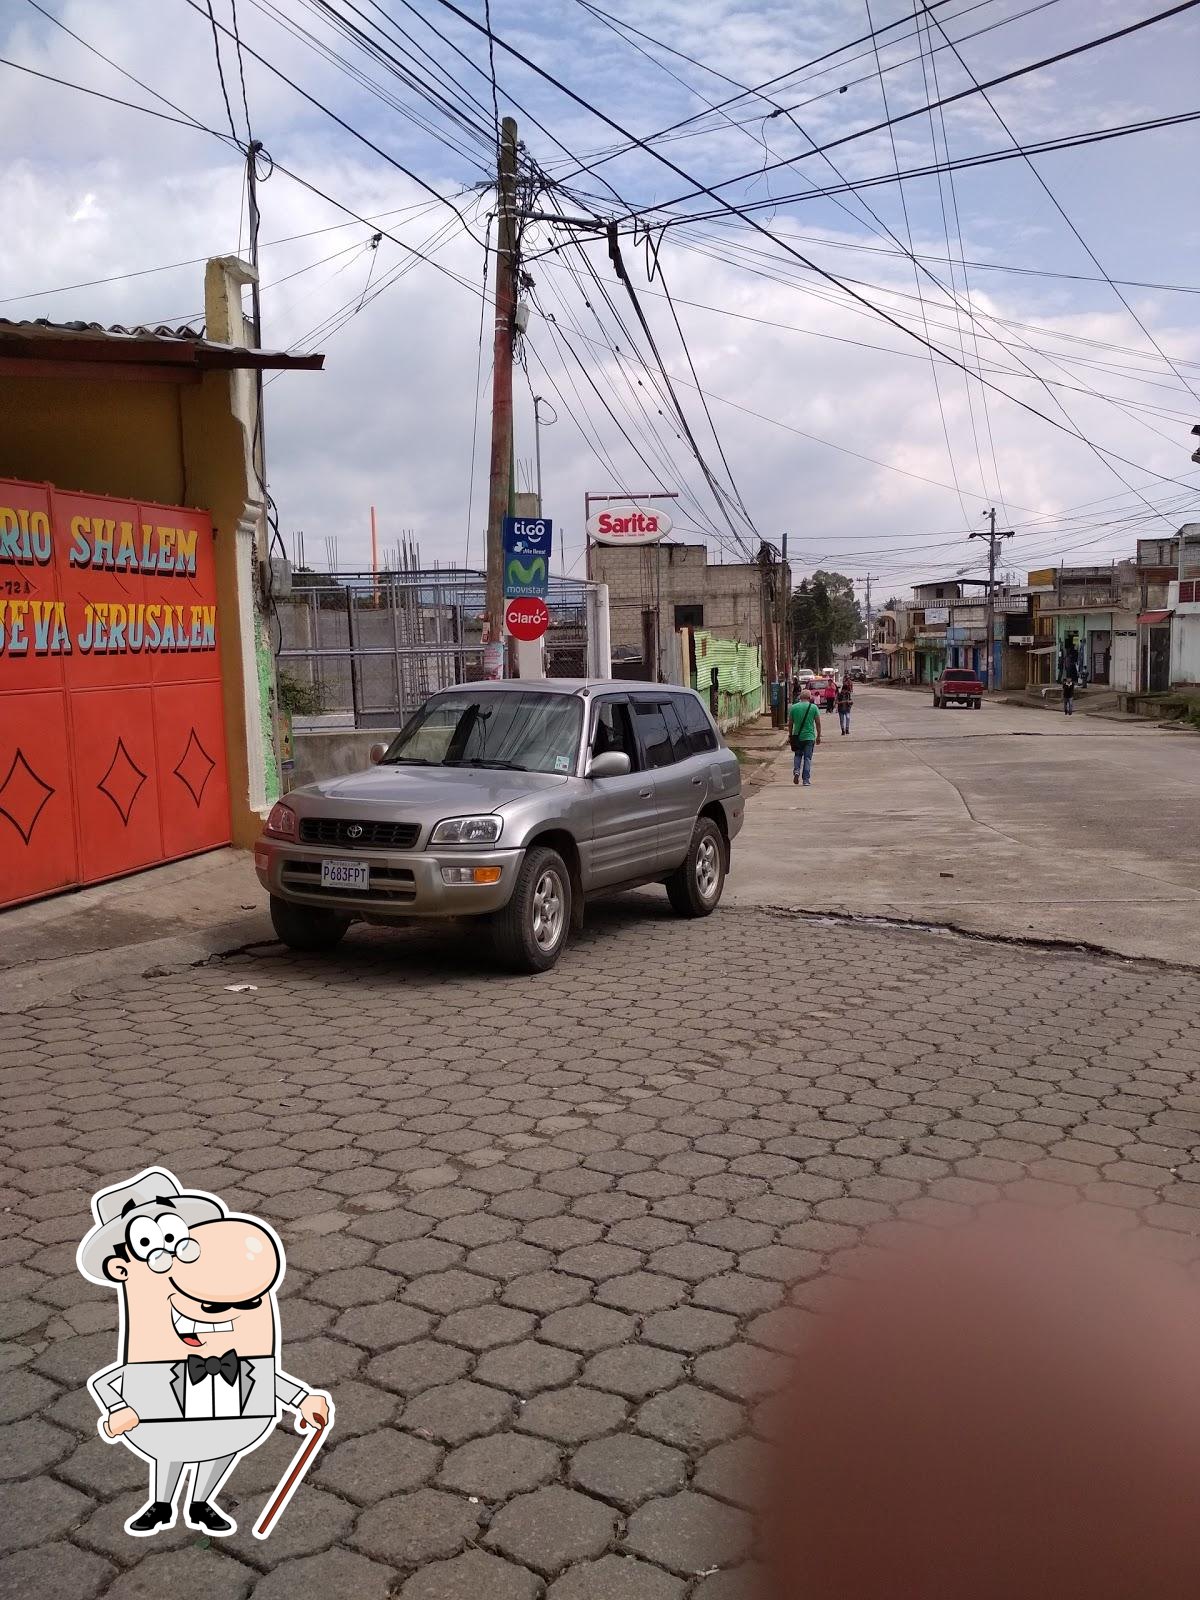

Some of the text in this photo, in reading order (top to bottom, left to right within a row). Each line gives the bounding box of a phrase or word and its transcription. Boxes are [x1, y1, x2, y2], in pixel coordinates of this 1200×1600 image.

[514, 520, 545, 543] tigo
[598, 513, 658, 534] Sarita
[70, 515, 198, 578] SHALEM
[507, 585, 545, 594] movistar
[508, 612, 542, 624] Claro
[78, 603, 216, 655] JERUSALEN
[323, 865, 366, 883] P683FPT
